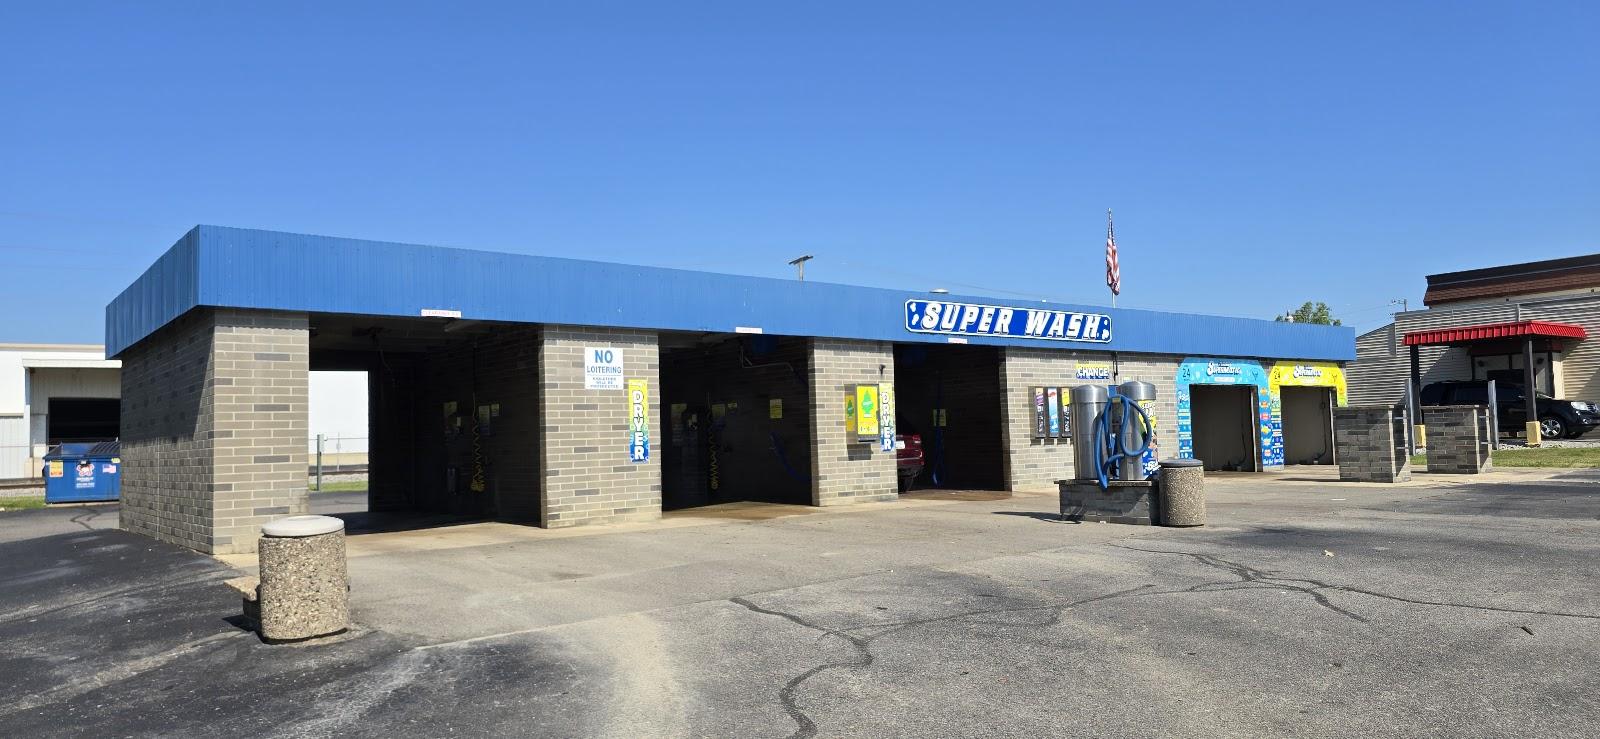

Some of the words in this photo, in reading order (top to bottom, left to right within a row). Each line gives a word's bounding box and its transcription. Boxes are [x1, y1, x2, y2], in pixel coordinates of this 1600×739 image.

[921, 302, 1013, 335] SUPER
[1024, 311, 1100, 340] WASH
[594, 349, 613, 364] NO
[586, 365, 622, 374] LOITERING
[1076, 367, 1109, 377] CHANGE
[1182, 368, 1191, 378] 24
[632, 390, 645, 460] DRYER
[881, 392, 892, 450] DRYER
